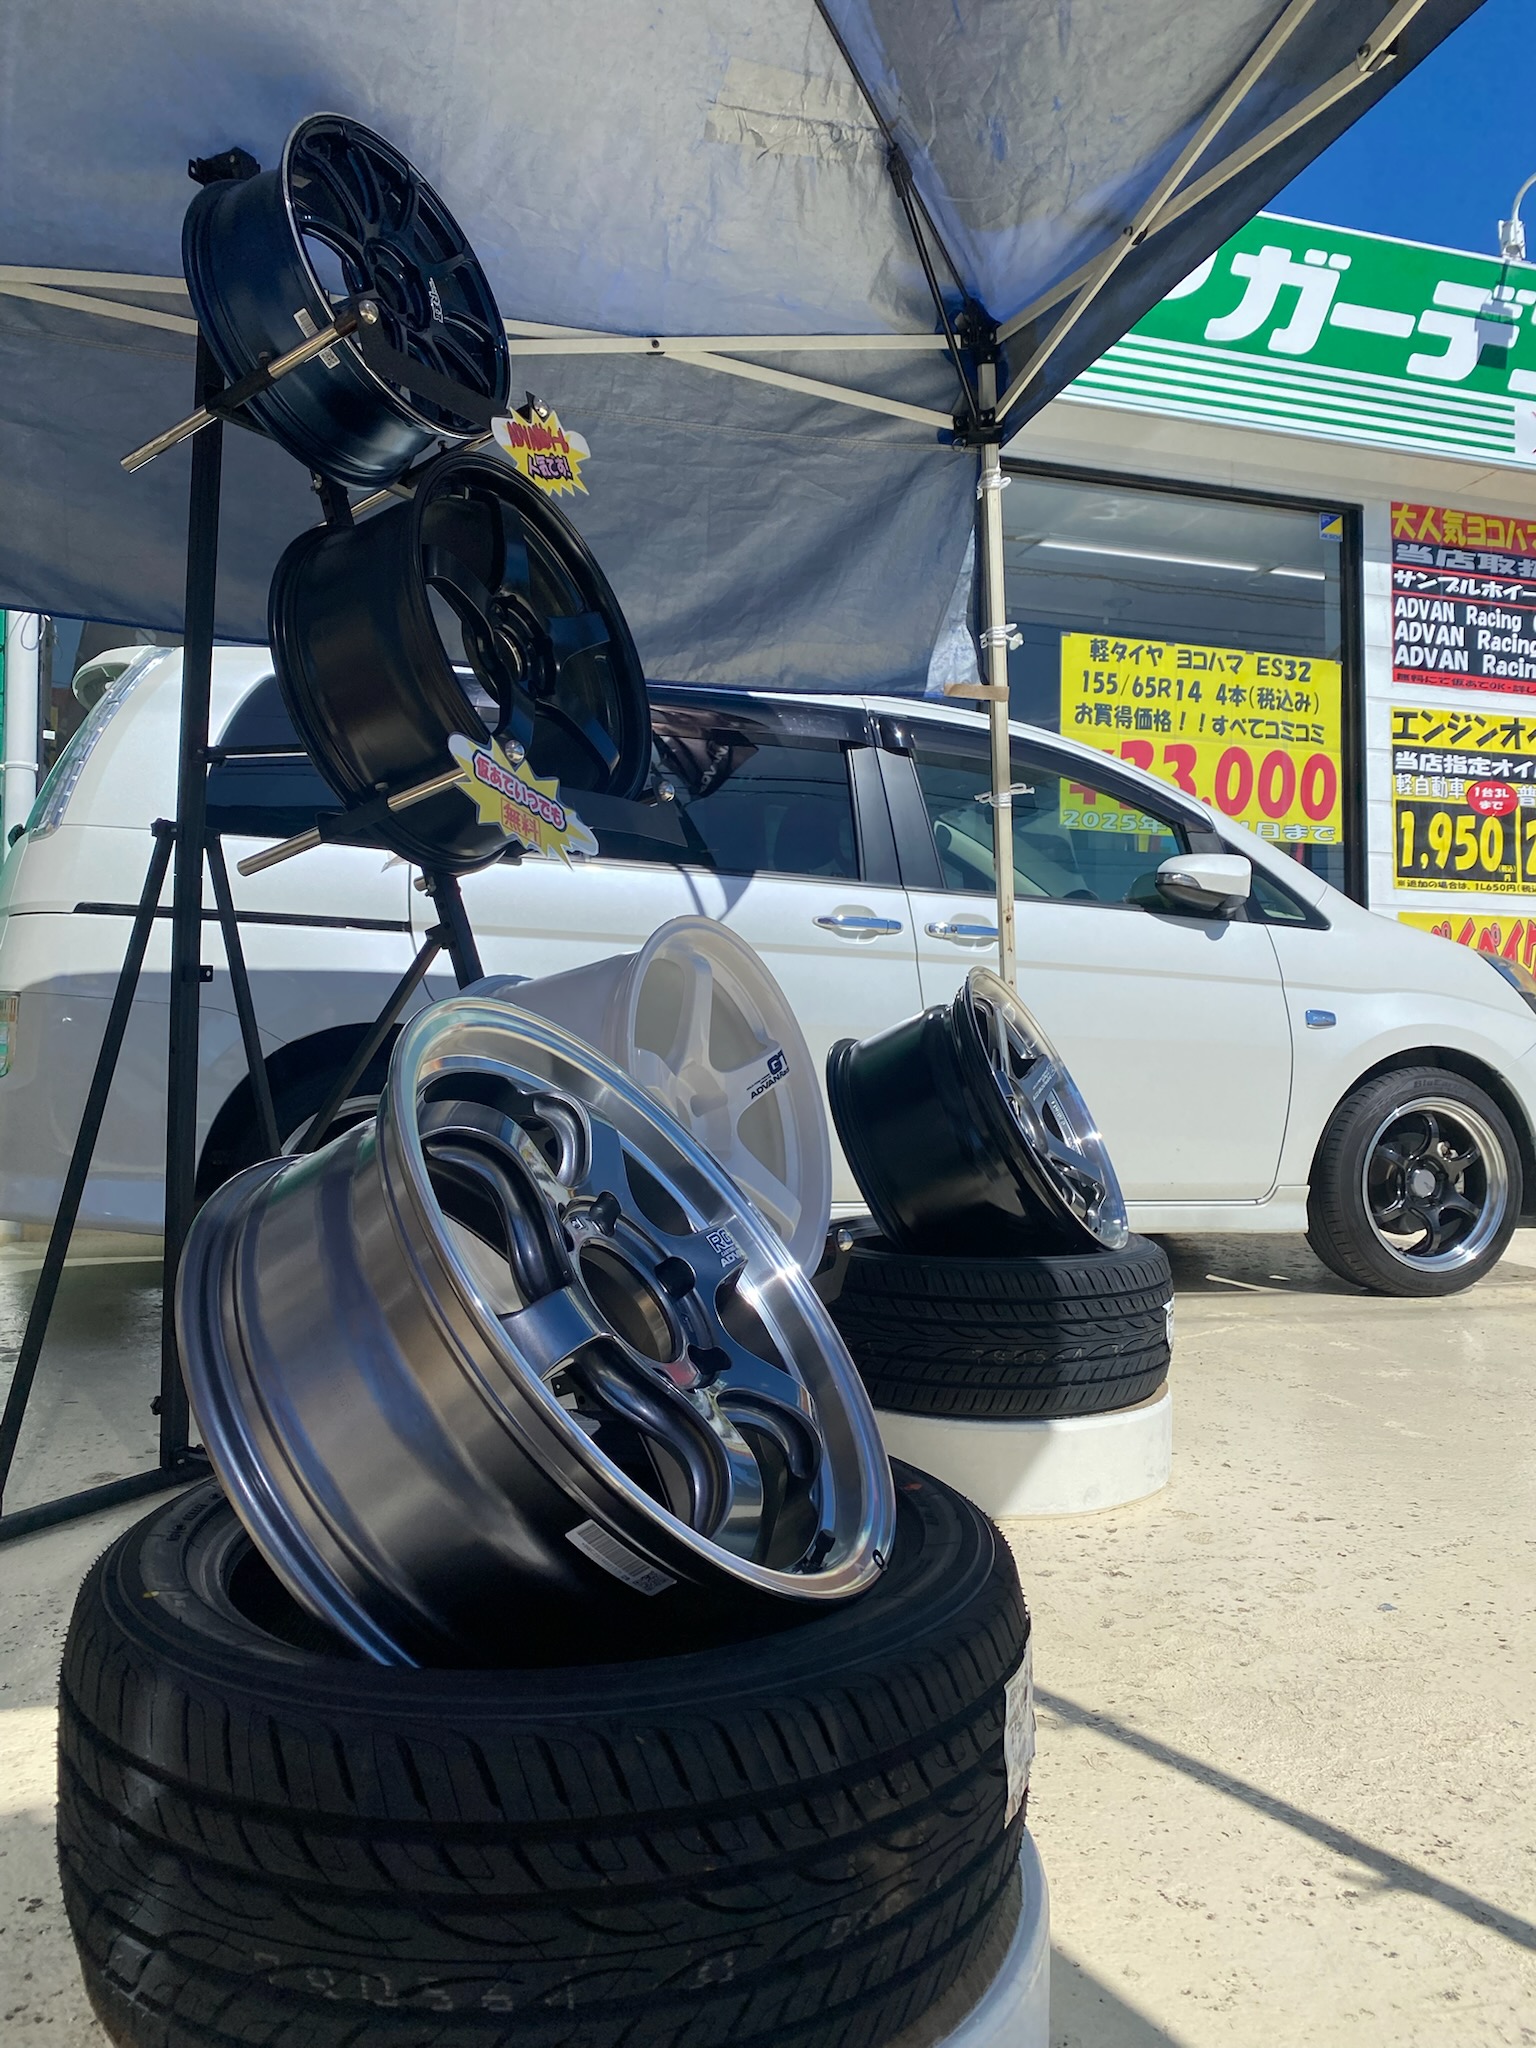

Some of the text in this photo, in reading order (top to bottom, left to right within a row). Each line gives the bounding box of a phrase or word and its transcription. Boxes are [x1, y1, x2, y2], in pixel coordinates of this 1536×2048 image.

[1164, 245, 1536, 396] ガーデ
[1395, 596, 1455, 623] ADVAN
[1466, 605, 1522, 633] Racing
[1395, 620, 1465, 647] ADVAN
[1090, 638, 1312, 683] 軽タイヤ ヨコハマ ES32
[1395, 645, 1469, 672] ADVAN
[1081, 670, 1203, 703] 155/65R14
[1395, 751, 1536, 779] 当店指定オイ
[476, 755, 564, 827] 仮あていつでも
[1395, 774, 1466, 799] 軽自動車
[503, 803, 540, 842] 無料
[1479, 800, 1504, 810] まで
[1401, 810, 1504, 872] 1,950
